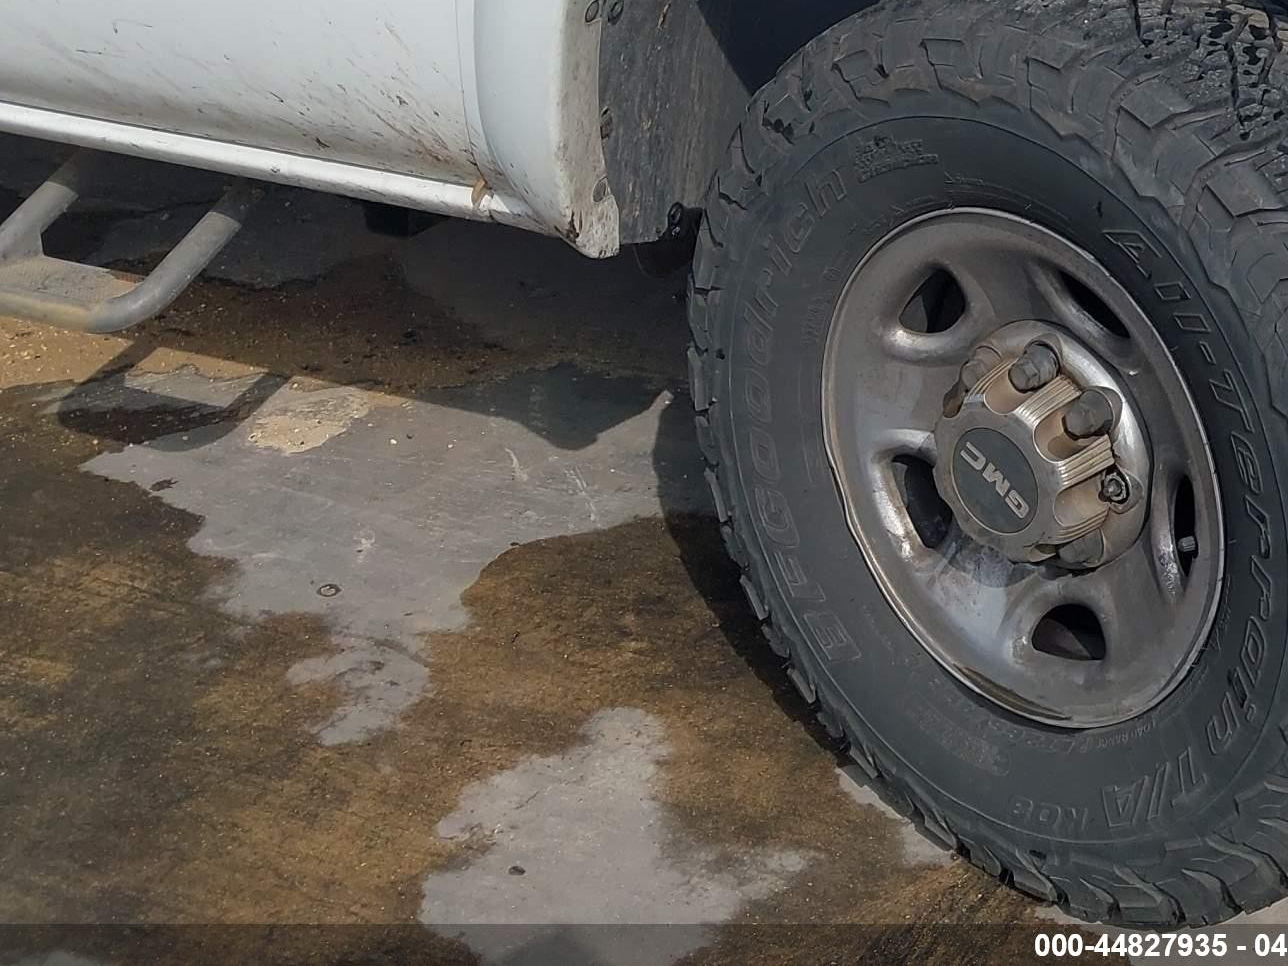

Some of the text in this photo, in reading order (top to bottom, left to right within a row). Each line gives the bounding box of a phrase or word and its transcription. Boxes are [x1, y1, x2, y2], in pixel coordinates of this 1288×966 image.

[744, 168, 862, 661] BFGoodrich
[960, 441, 1030, 519] GMC
[1102, 230, 1272, 755] All-Terrain
[1101, 746, 1209, 827] T/A
